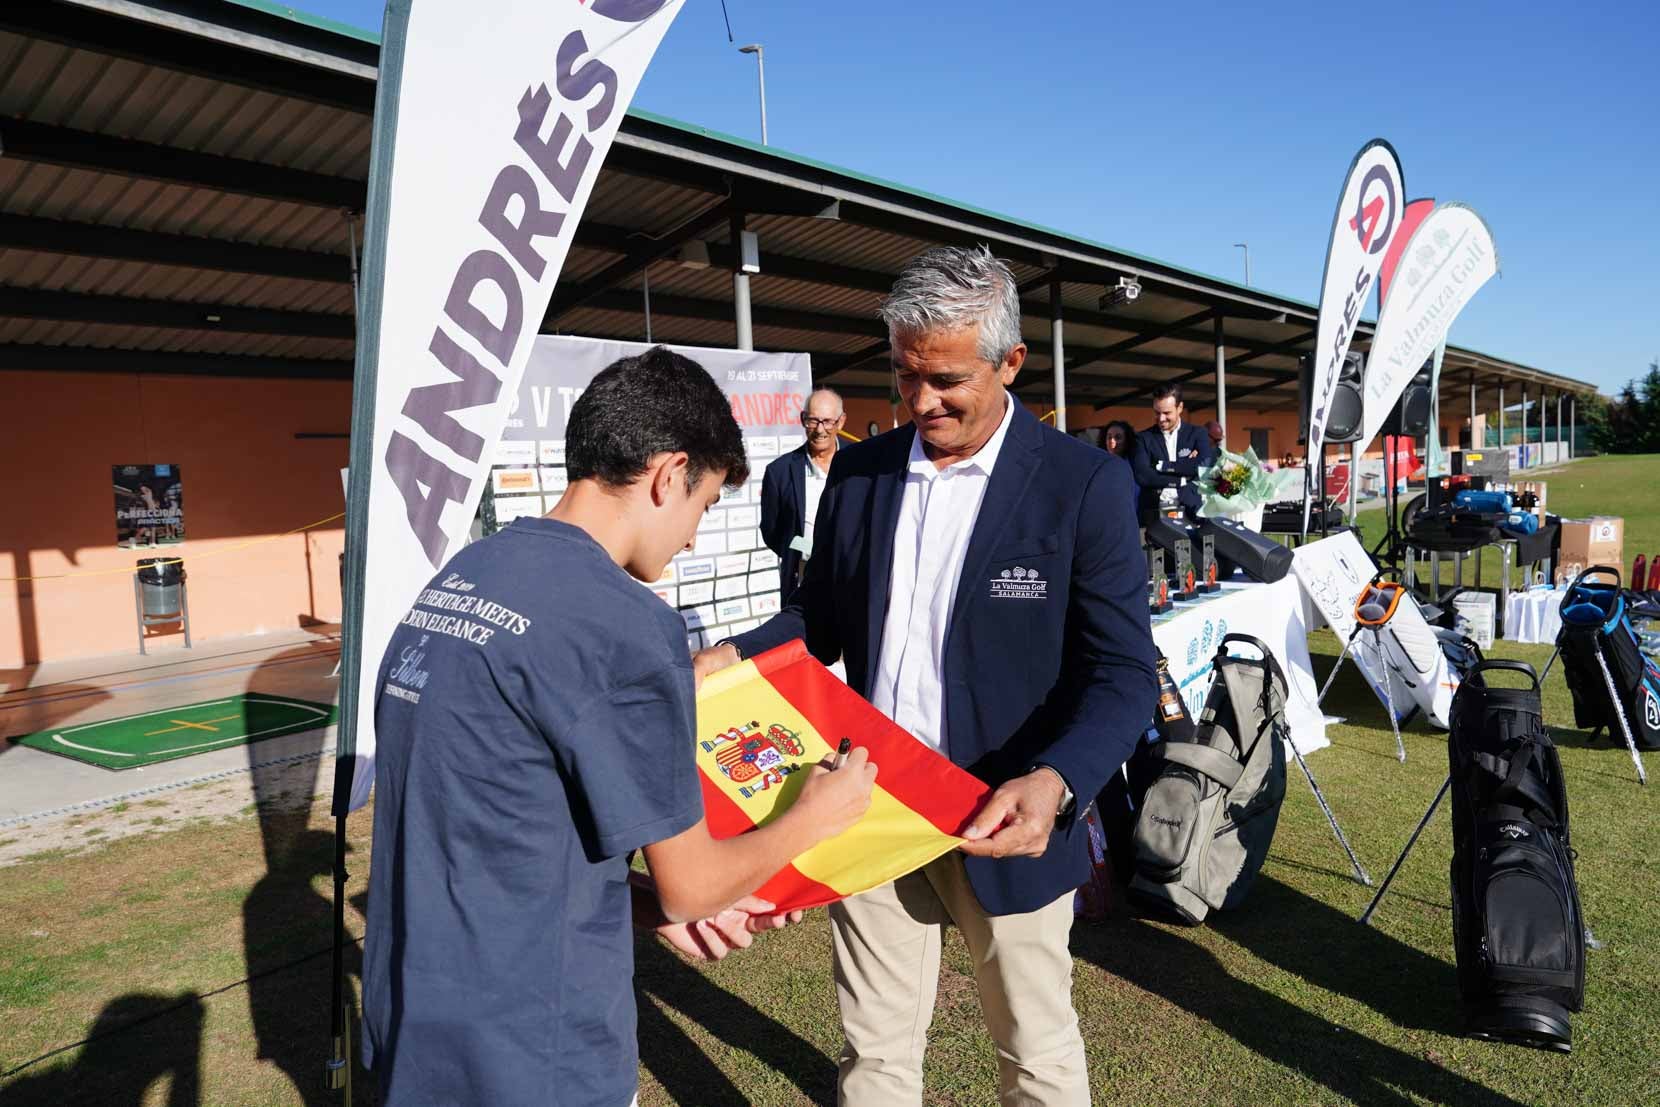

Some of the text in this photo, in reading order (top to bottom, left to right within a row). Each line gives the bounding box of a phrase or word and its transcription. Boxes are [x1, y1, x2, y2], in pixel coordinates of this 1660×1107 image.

[385, 29, 618, 571] ANDRÉS
[1371, 237, 1486, 399] La Valmuza Golf
[423, 590, 476, 613] HERITAGE
[471, 598, 531, 635] MEETS
[424, 613, 495, 646] ELEGANCE
